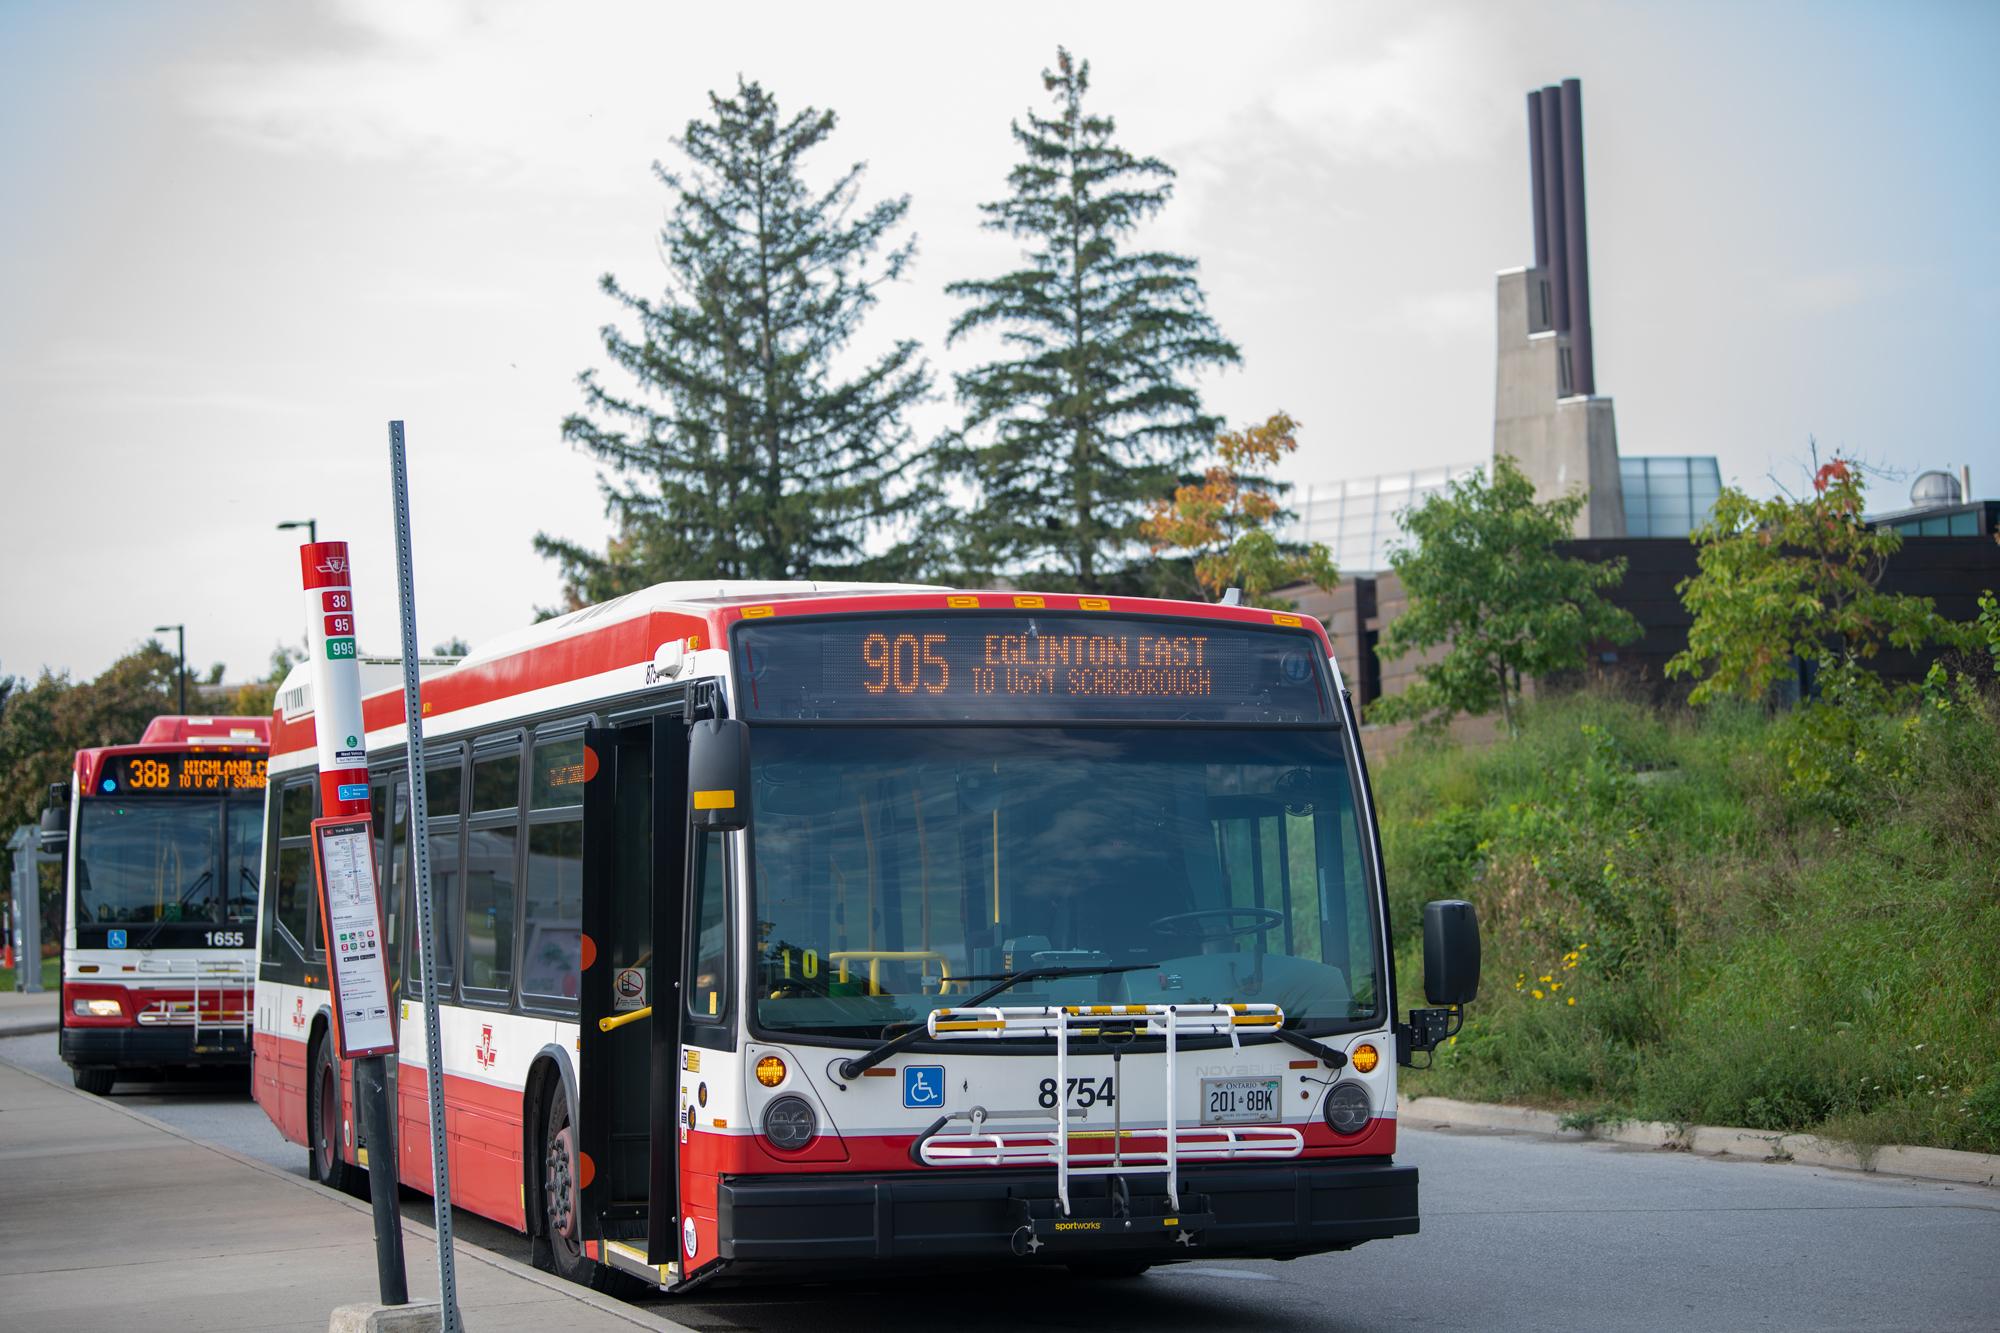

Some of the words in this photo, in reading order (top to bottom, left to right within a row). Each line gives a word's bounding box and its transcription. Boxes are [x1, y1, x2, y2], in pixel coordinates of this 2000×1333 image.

[332, 594, 347, 608] 38
[334, 618, 349, 632] 95
[332, 642, 354, 656] 995
[863, 633, 949, 694] 905
[985, 634, 1127, 665] EGLINTON
[1139, 636, 1208, 666] EAST
[971, 667, 995, 694] TO
[1068, 668, 1211, 695] SCARBOROUGH
[129, 759, 170, 788] 38B
[183, 760, 252, 776] HIGHLAND
[179, 775, 191, 788] TO
[194, 775, 203, 788] U
[206, 775, 219, 788] of
[223, 775, 230, 788] T
[204, 931, 244, 947] 1655
[1038, 1076, 1116, 1109] 8754
[1055, 1221, 1101, 1231] sportworks
